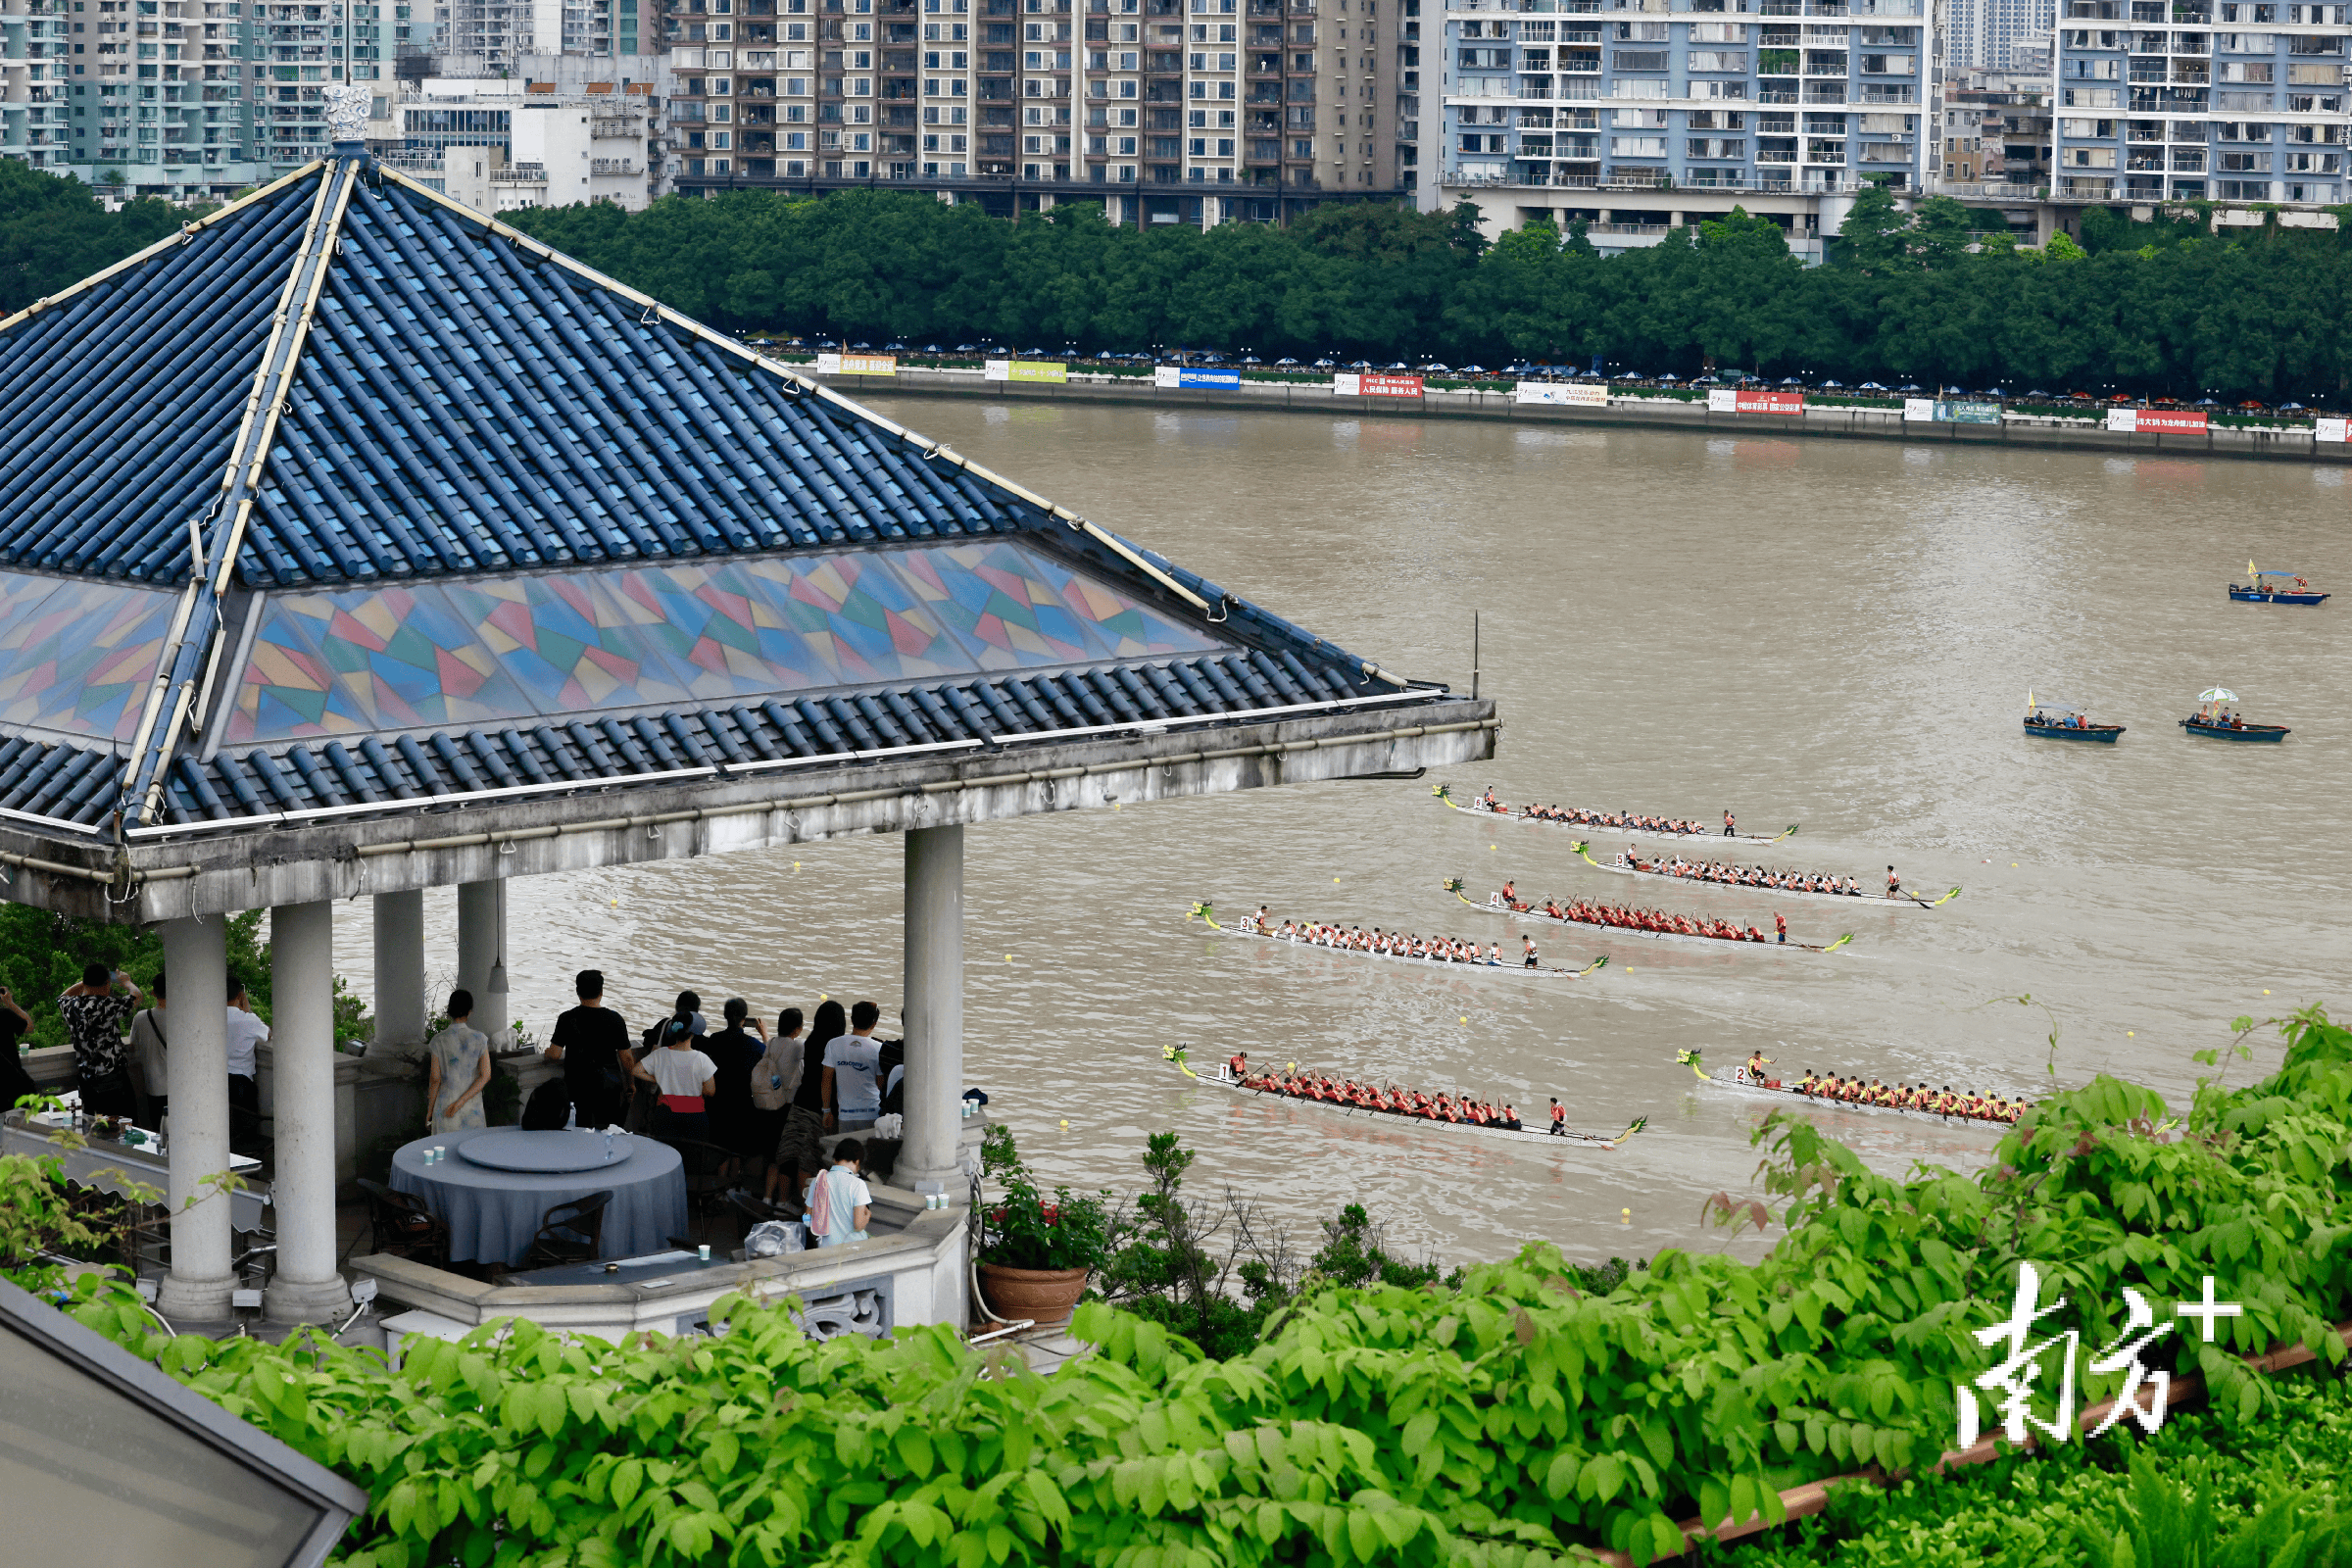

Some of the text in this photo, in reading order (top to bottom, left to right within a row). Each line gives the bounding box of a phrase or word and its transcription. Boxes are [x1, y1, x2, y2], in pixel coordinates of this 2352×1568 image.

[1391, 386, 1418, 395] 服务人民
[2136, 417, 2160, 426] 钱大妈
[2161, 418, 2206, 428] 为龙舟健儿加油
